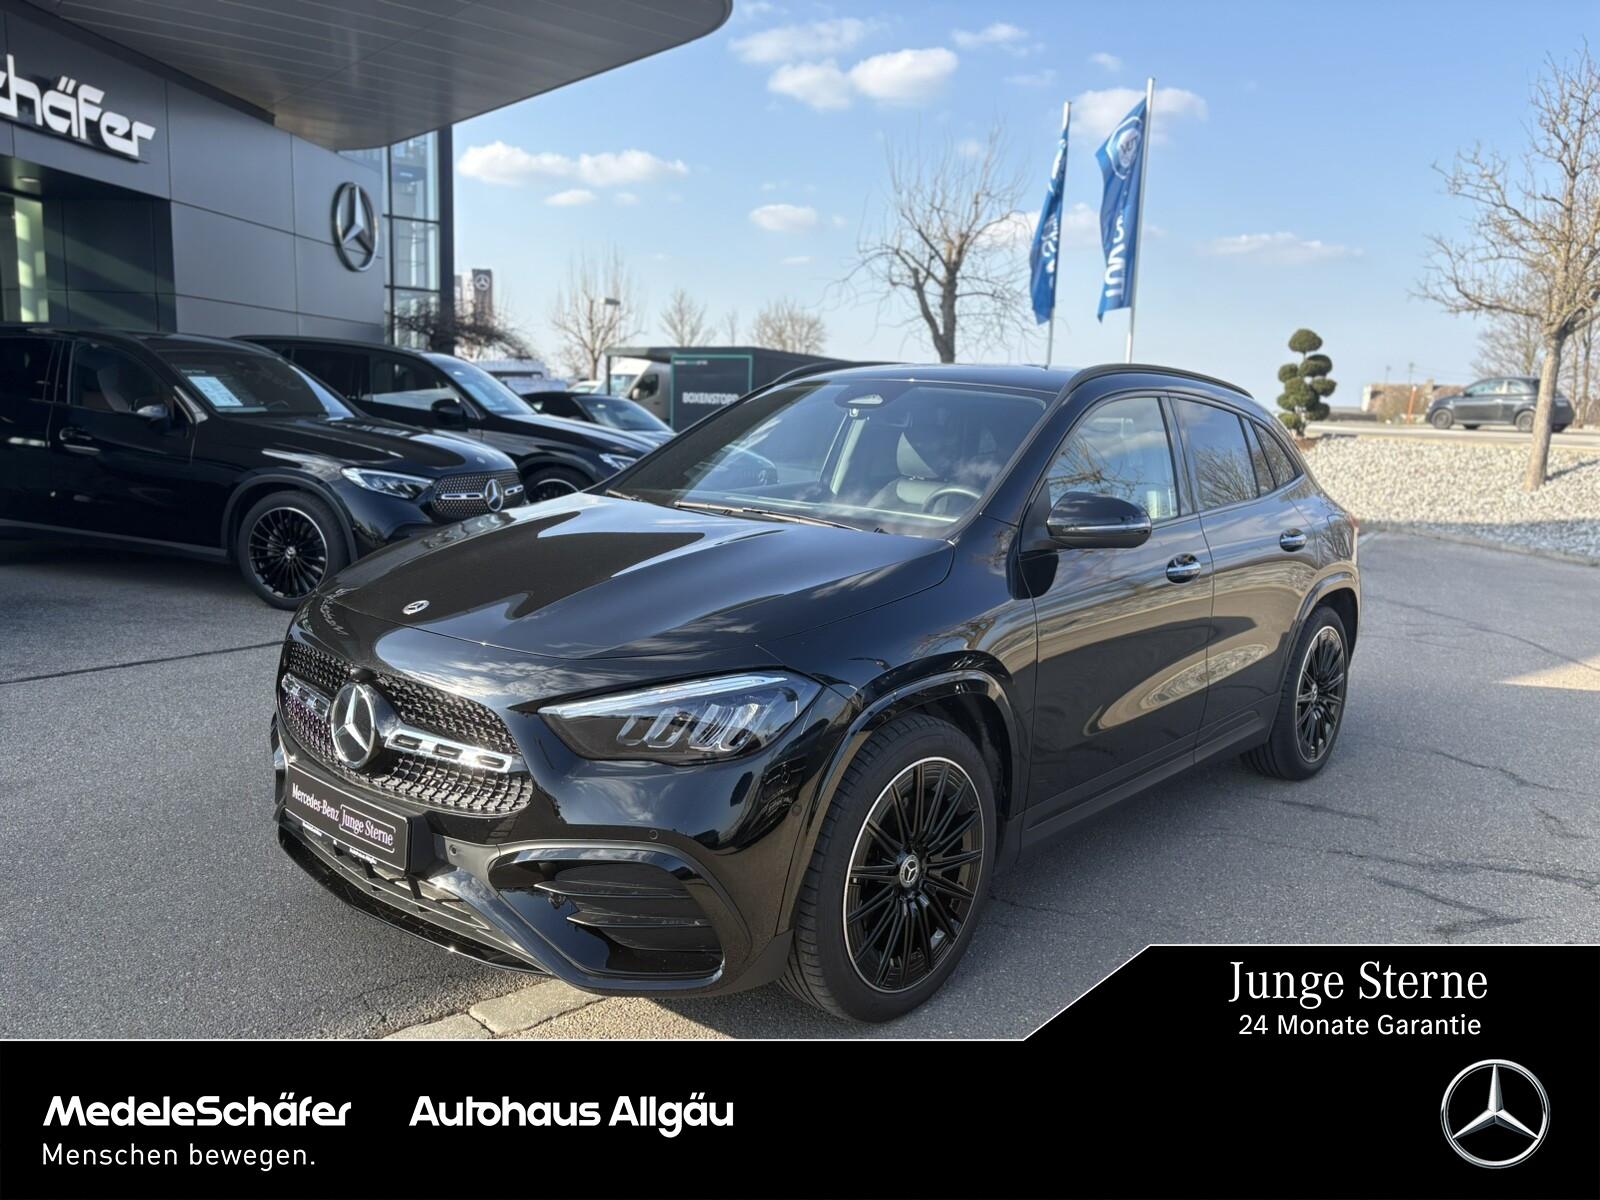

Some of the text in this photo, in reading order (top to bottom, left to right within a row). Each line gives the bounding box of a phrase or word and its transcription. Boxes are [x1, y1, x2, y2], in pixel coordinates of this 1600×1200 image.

[292, 782, 340, 822] Mercedes-Benz
[341, 809, 364, 834] Junge
[364, 820, 394, 847] Sterne
